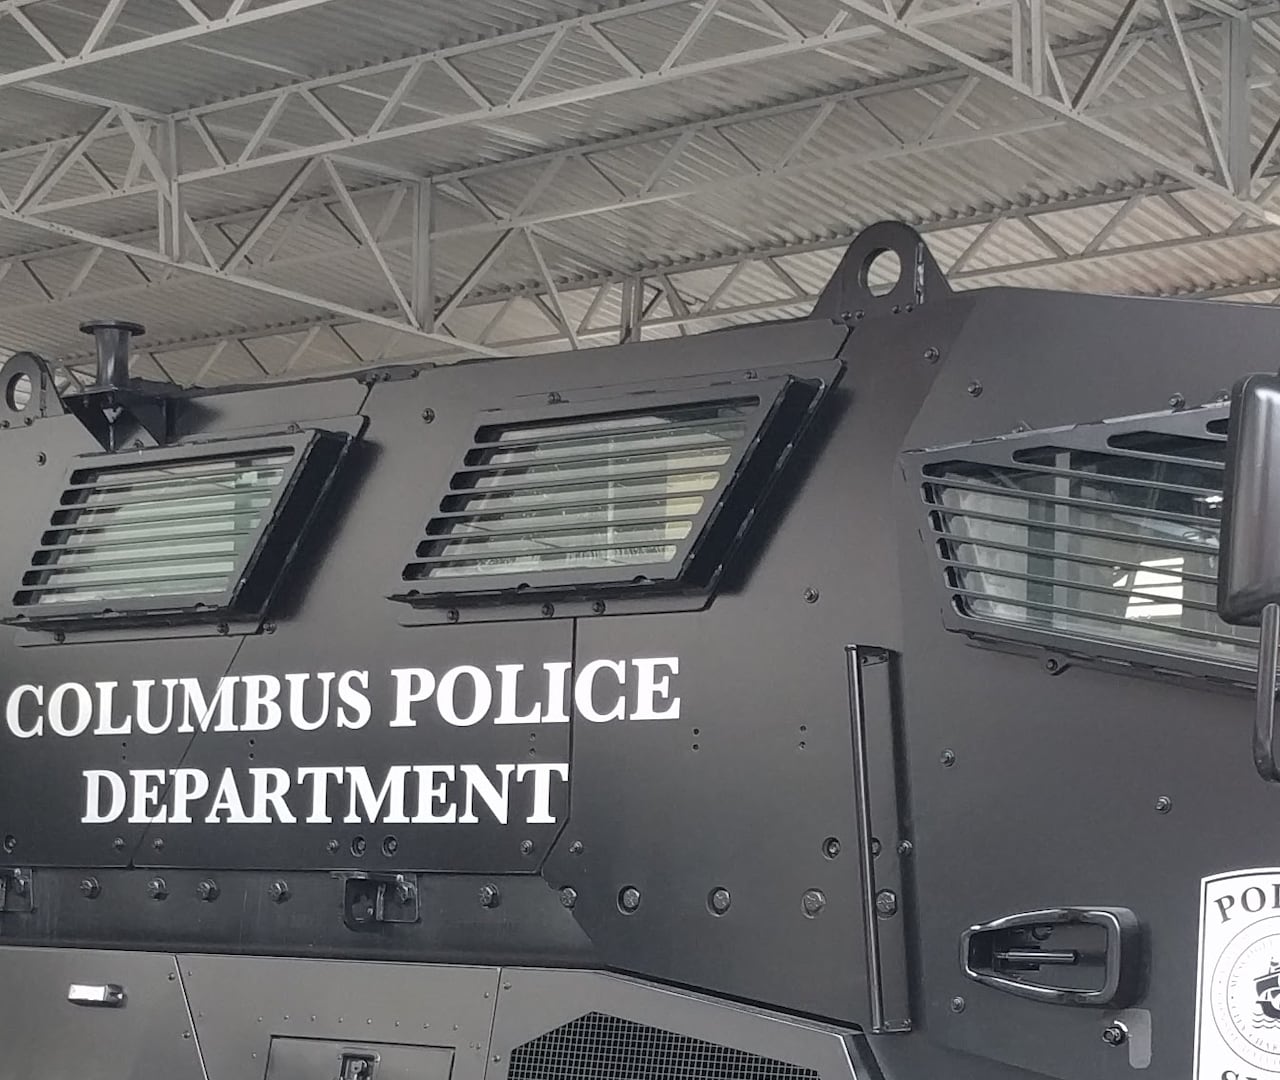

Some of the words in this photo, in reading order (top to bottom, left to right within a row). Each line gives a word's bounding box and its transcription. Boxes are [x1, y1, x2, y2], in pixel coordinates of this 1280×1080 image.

[6, 670, 371, 737] COLUMBUS
[390, 657, 680, 727] POLICE
[82, 763, 568, 824] DEPARTMENT
